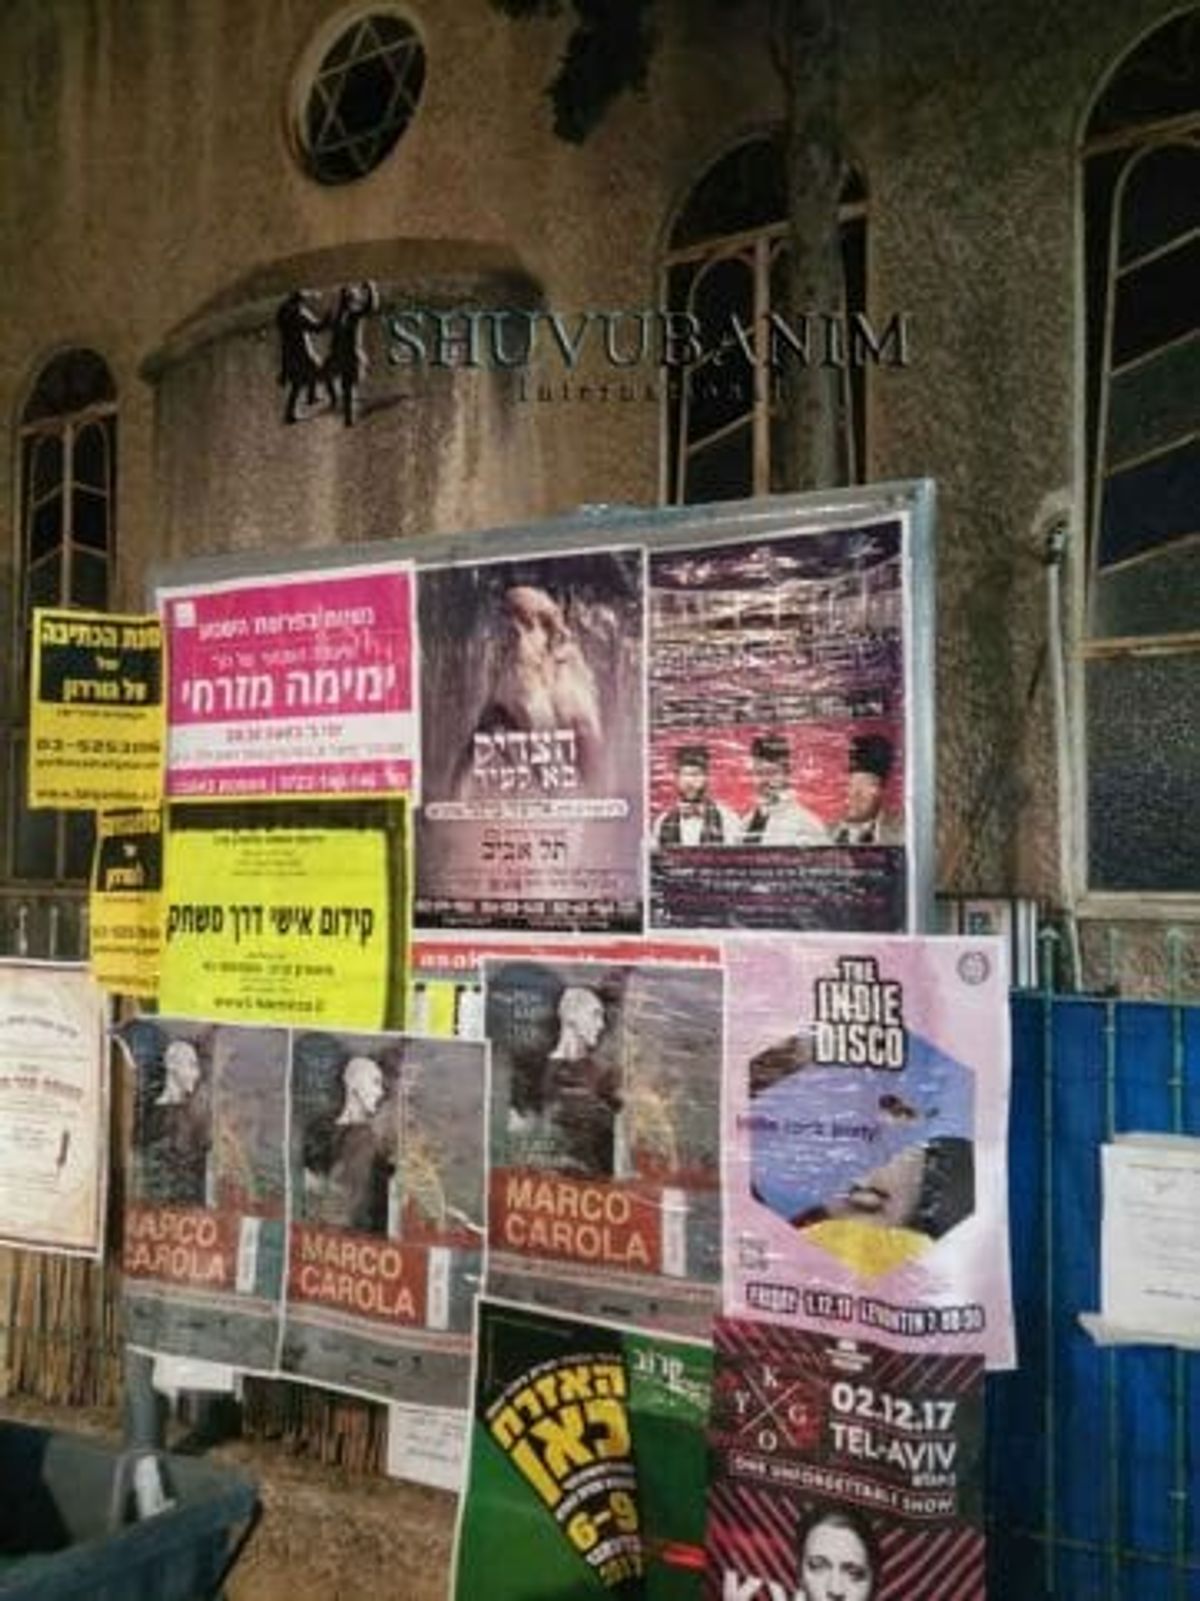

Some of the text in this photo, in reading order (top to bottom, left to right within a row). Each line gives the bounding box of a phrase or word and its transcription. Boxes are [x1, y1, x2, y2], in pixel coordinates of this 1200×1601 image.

[181, 664, 397, 714] ימימה מזרחי
[165, 902, 374, 947] קידום אישי דרך משחק
[816, 981, 901, 1026] INDIE
[815, 1023, 904, 1067] DISCO
[505, 1175, 631, 1225] MARCO
[301, 1233, 403, 1279] MARCO
[504, 1212, 651, 1267] CAROLA
[300, 1265, 417, 1319] CAROLA
[830, 1380, 957, 1431] 02.12.17
[830, 1422, 957, 1472] TEL-AVIV
